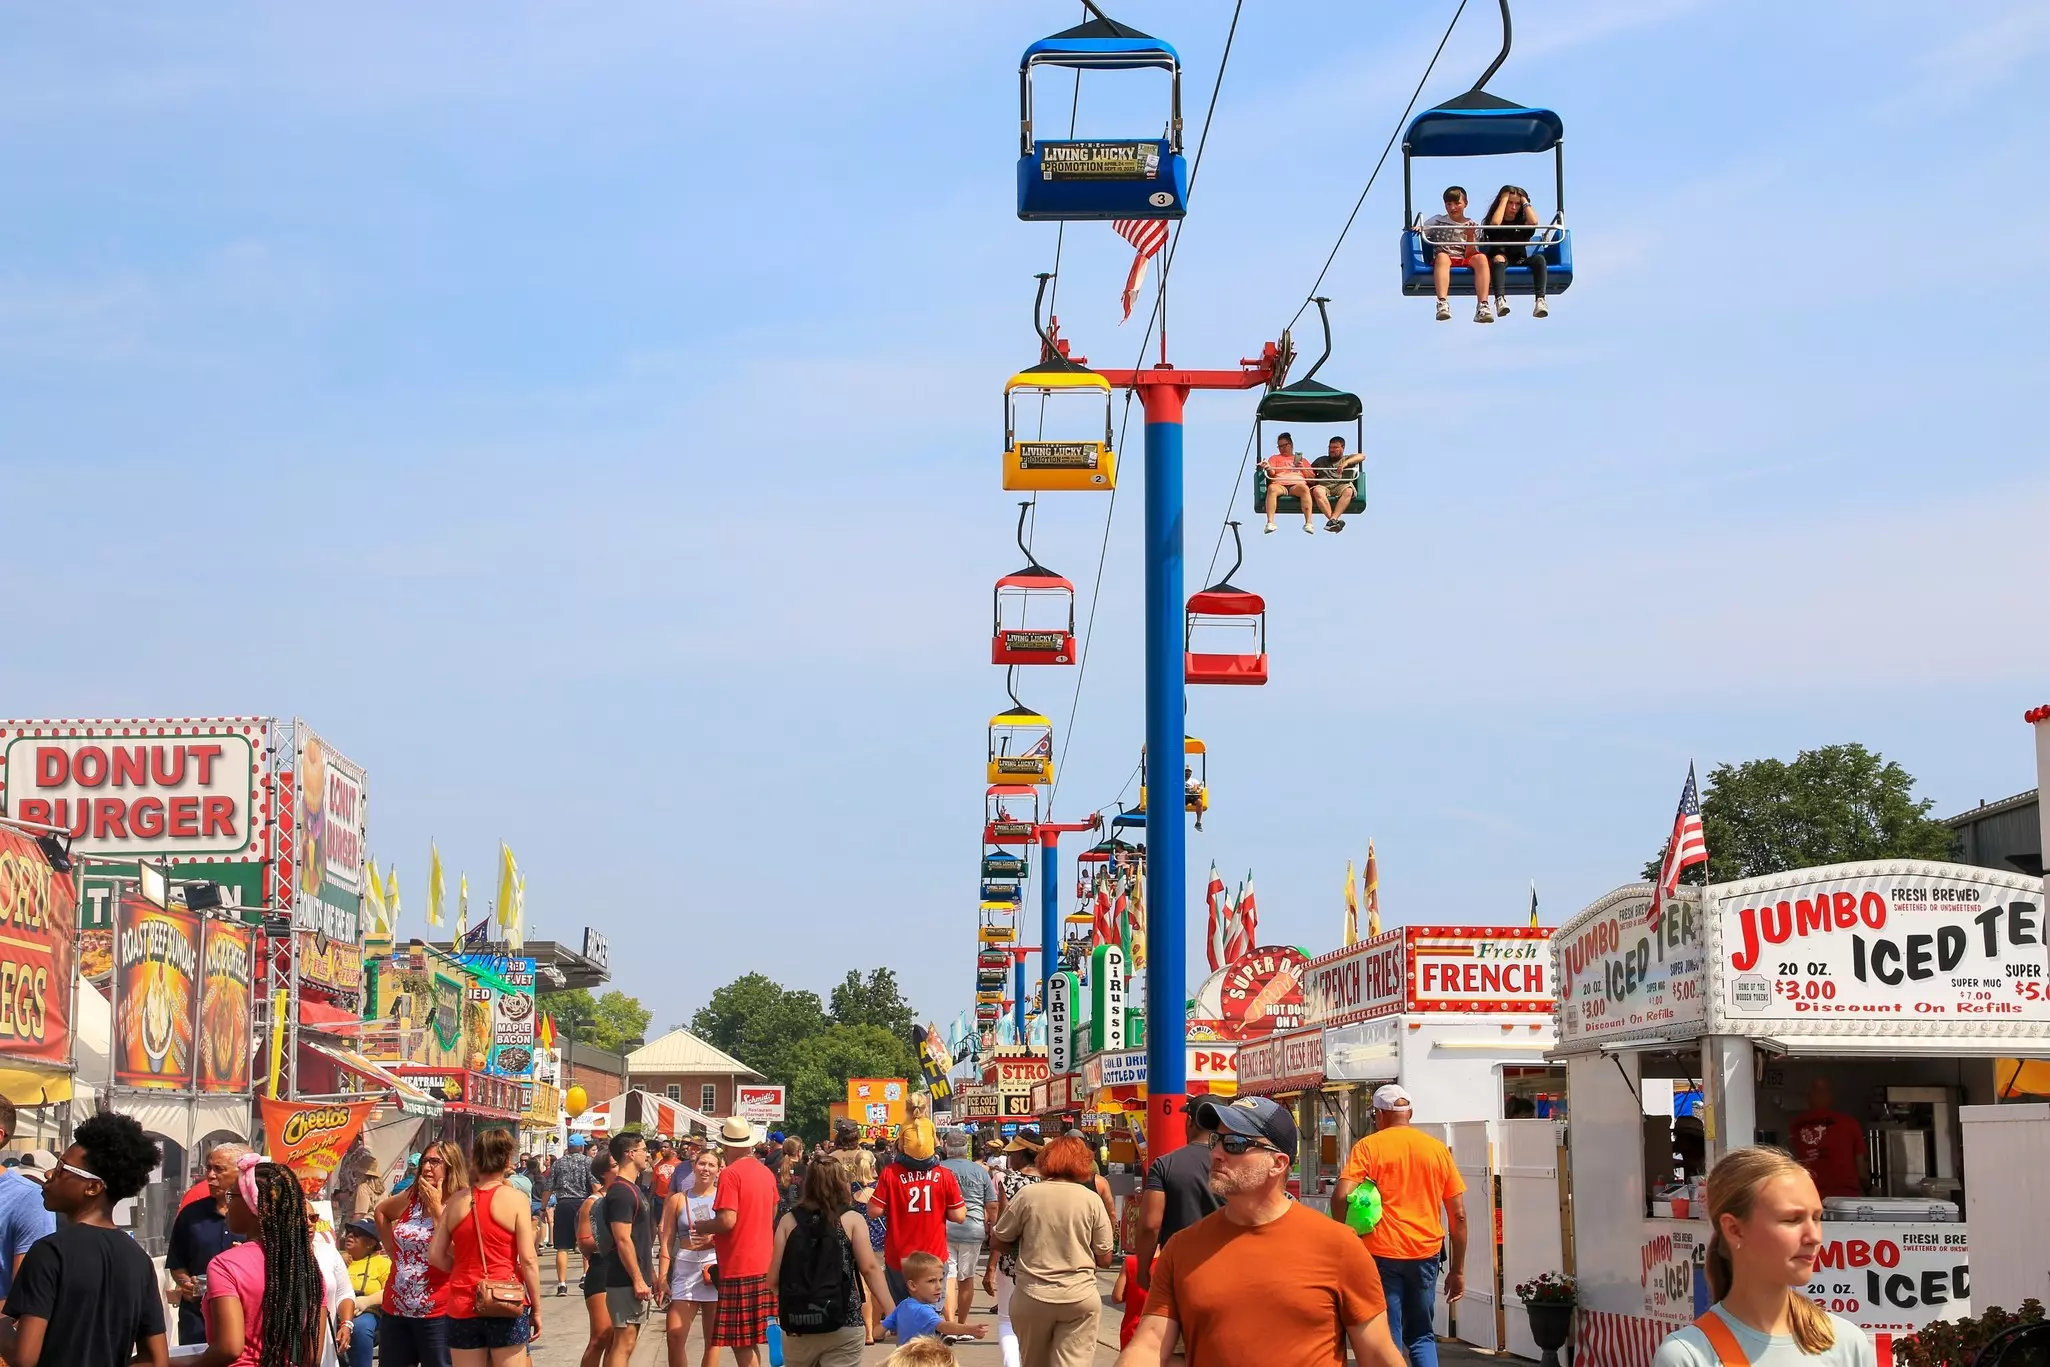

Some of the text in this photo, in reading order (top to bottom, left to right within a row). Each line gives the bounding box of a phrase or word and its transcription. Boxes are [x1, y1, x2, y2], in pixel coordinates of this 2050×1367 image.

[1044, 147, 1136, 161] LIVING LUCKY
[1045, 161, 1103, 171] PROMOTION
[1157, 194, 1166, 204] 3
[1022, 447, 1082, 456] LIVING LUCKY
[36, 745, 221, 787] DONUT
[329, 773, 357, 827] DONUT
[18, 796, 237, 839] BURGER
[326, 819, 358, 871] BURGER
[1892, 888, 1980, 902] FRESH BREWED
[1619, 905, 1634, 921] FRESH
[1893, 903, 1928, 912] SWEETENED
[1940, 904, 1982, 912] UNSWEETENED
[1731, 891, 1887, 972] JUMBO
[122, 920, 149, 966] ROAST
[150, 919, 168, 956] BEEF
[1852, 901, 2048, 986] ICED TE
[1476, 943, 1538, 959] Fresh
[1562, 918, 1620, 1000] JUMBO
[1605, 901, 1697, 1004] ICED TEA
[507, 962, 526, 972] RED
[1670, 961, 1684, 977] SUPER
[1778, 962, 1832, 976] 20 OZ.
[2005, 964, 2041, 977] SUPER
[1229, 957, 1275, 1000] SUPER
[1320, 960, 1360, 1012] FRENCH
[1366, 943, 1401, 1001] FRIES
[1422, 963, 1544, 993] FRENCH
[1951, 978, 2002, 988] SUPER MUG
[1583, 984, 1591, 995] 20
[1646, 983, 1657, 994] SUPER
[1672, 980, 1697, 1001] $5.00
[1738, 983, 1766, 991] HOME OF THE
[1775, 979, 1837, 1001] $3.00
[1109, 953, 1122, 1050] DiRusso'
[1735, 993, 1769, 1001] WOODEN TOKENS
[1960, 991, 1992, 1001] $7.00
[1266, 1005, 1304, 1015] HOT DO
[1581, 998, 1606, 1020] $3.00
[1795, 1002, 2023, 1013] Discount On Refills
[1050, 979, 1066, 1069] DiRusso's
[1276, 1017, 1298, 1027] ON A
[1585, 1018, 1625, 1032] Discount
[1630, 1014, 1643, 1024] On
[1646, 1008, 1674, 1022] Refills
[497, 1023, 532, 1034] MAPLE
[1190, 1026, 1212, 1037] FAMILY
[496, 1034, 531, 1045] BACON
[1286, 1038, 1323, 1071] CHEESE FRIES
[919, 1041, 951, 1100] ATM
[1104, 1057, 1122, 1069] COLD
[1002, 1064, 1049, 1080] STRO
[1104, 1069, 1135, 1083] BOTTLED
[741, 1091, 776, 1105] Schmidt's
[968, 1096, 998, 1106] ICE COLD
[970, 1105, 996, 1115] DRINKS
[1162, 1099, 1172, 1115] 6
[284, 1106, 349, 1145] Cheetos
[900, 1169, 941, 1185] GREENE
[908, 1185, 932, 1213] 21
[1903, 1234, 1967, 1245] FRESH BRE
[1641, 1235, 1673, 1288] JUMBO
[1812, 1239, 1901, 1273] MBO
[1664, 1259, 1690, 1301] ICED
[1866, 1265, 1971, 1309] ICED
[1807, 1284, 1855, 1294] 20 OZ.
[788, 1313, 823, 1326] PUMA
